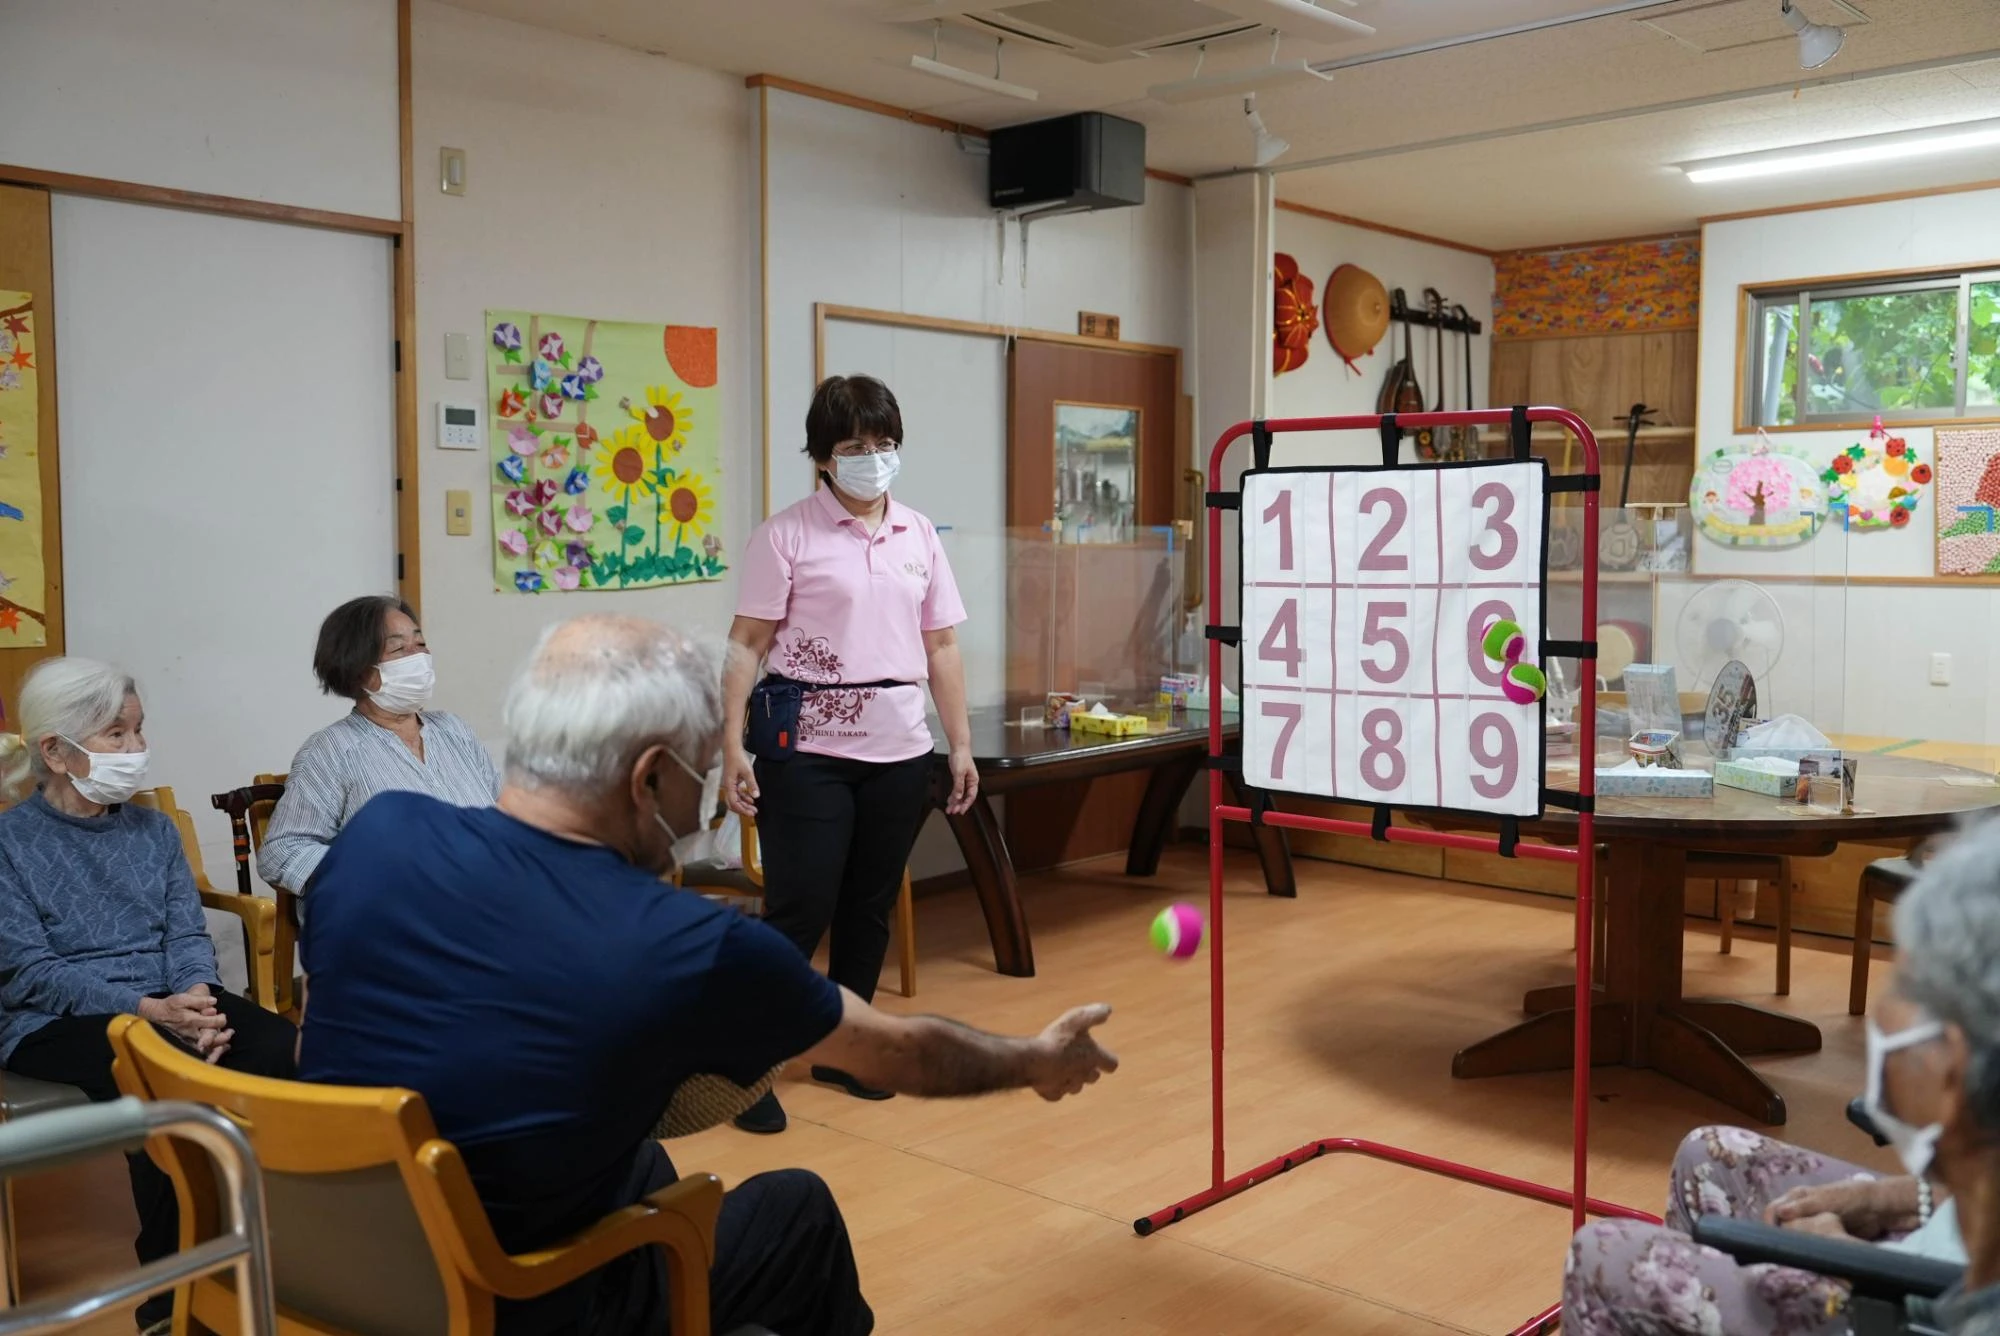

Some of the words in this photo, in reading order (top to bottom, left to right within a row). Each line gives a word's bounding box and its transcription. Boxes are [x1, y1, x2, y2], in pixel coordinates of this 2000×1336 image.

[1263, 490, 1293, 570] 1
[1357, 487, 1408, 571] 2
[1469, 482, 1519, 571] 3
[1258, 599, 1307, 678] 4
[1360, 602, 1410, 684] 5
[1261, 702, 1304, 780] 7
[1359, 708, 1406, 791] 8
[1470, 712, 1519, 799] 9
